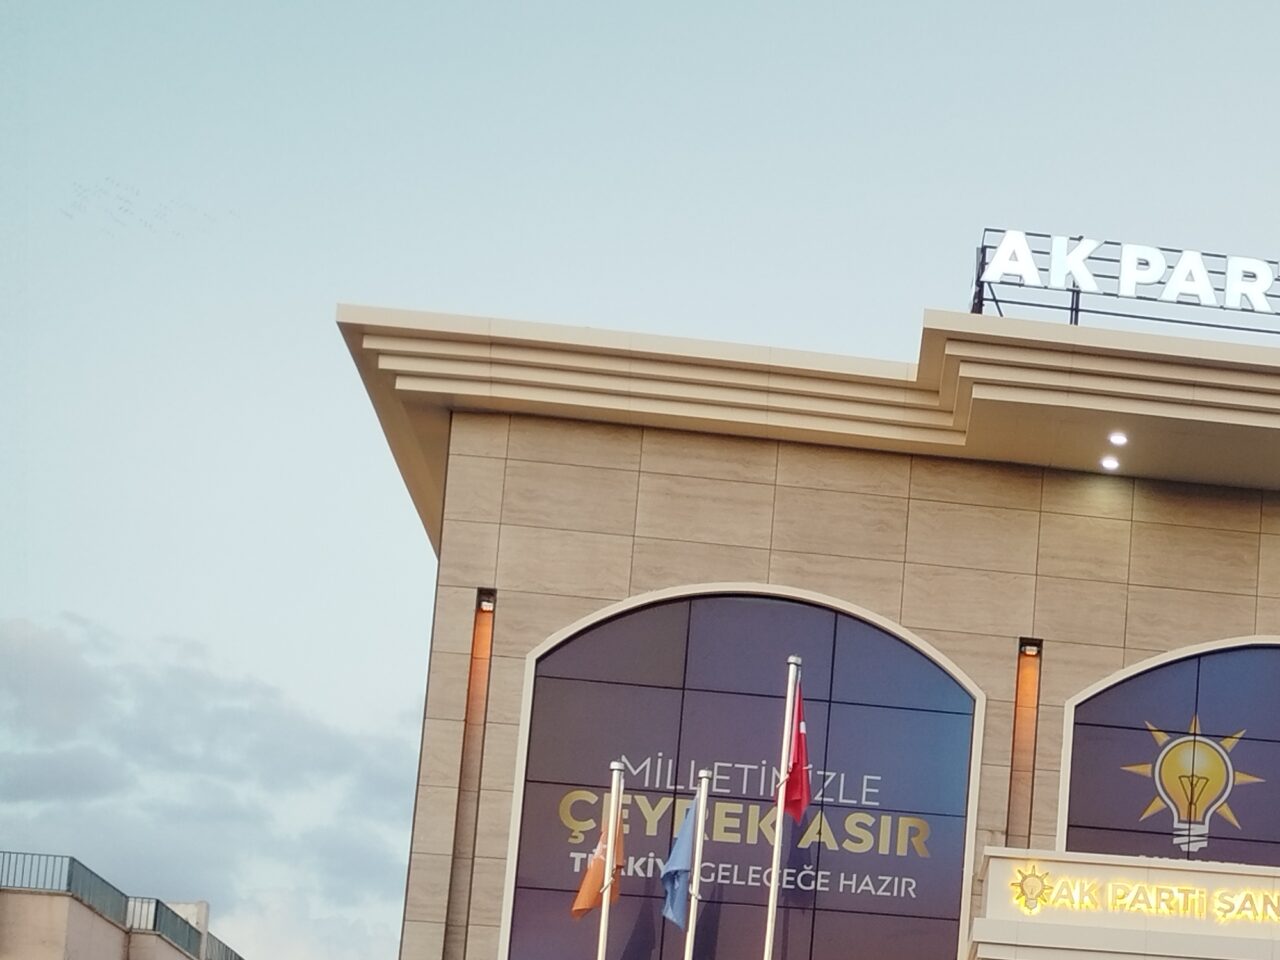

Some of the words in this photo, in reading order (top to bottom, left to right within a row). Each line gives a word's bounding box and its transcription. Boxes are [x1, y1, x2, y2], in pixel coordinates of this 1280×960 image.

[981, 229, 1106, 293] AK
[797, 810, 931, 859] ASIR
[838, 873, 917, 899] HAZIR
[1050, 877, 1099, 911] AK
[1108, 882, 1208, 919] PARTİ
